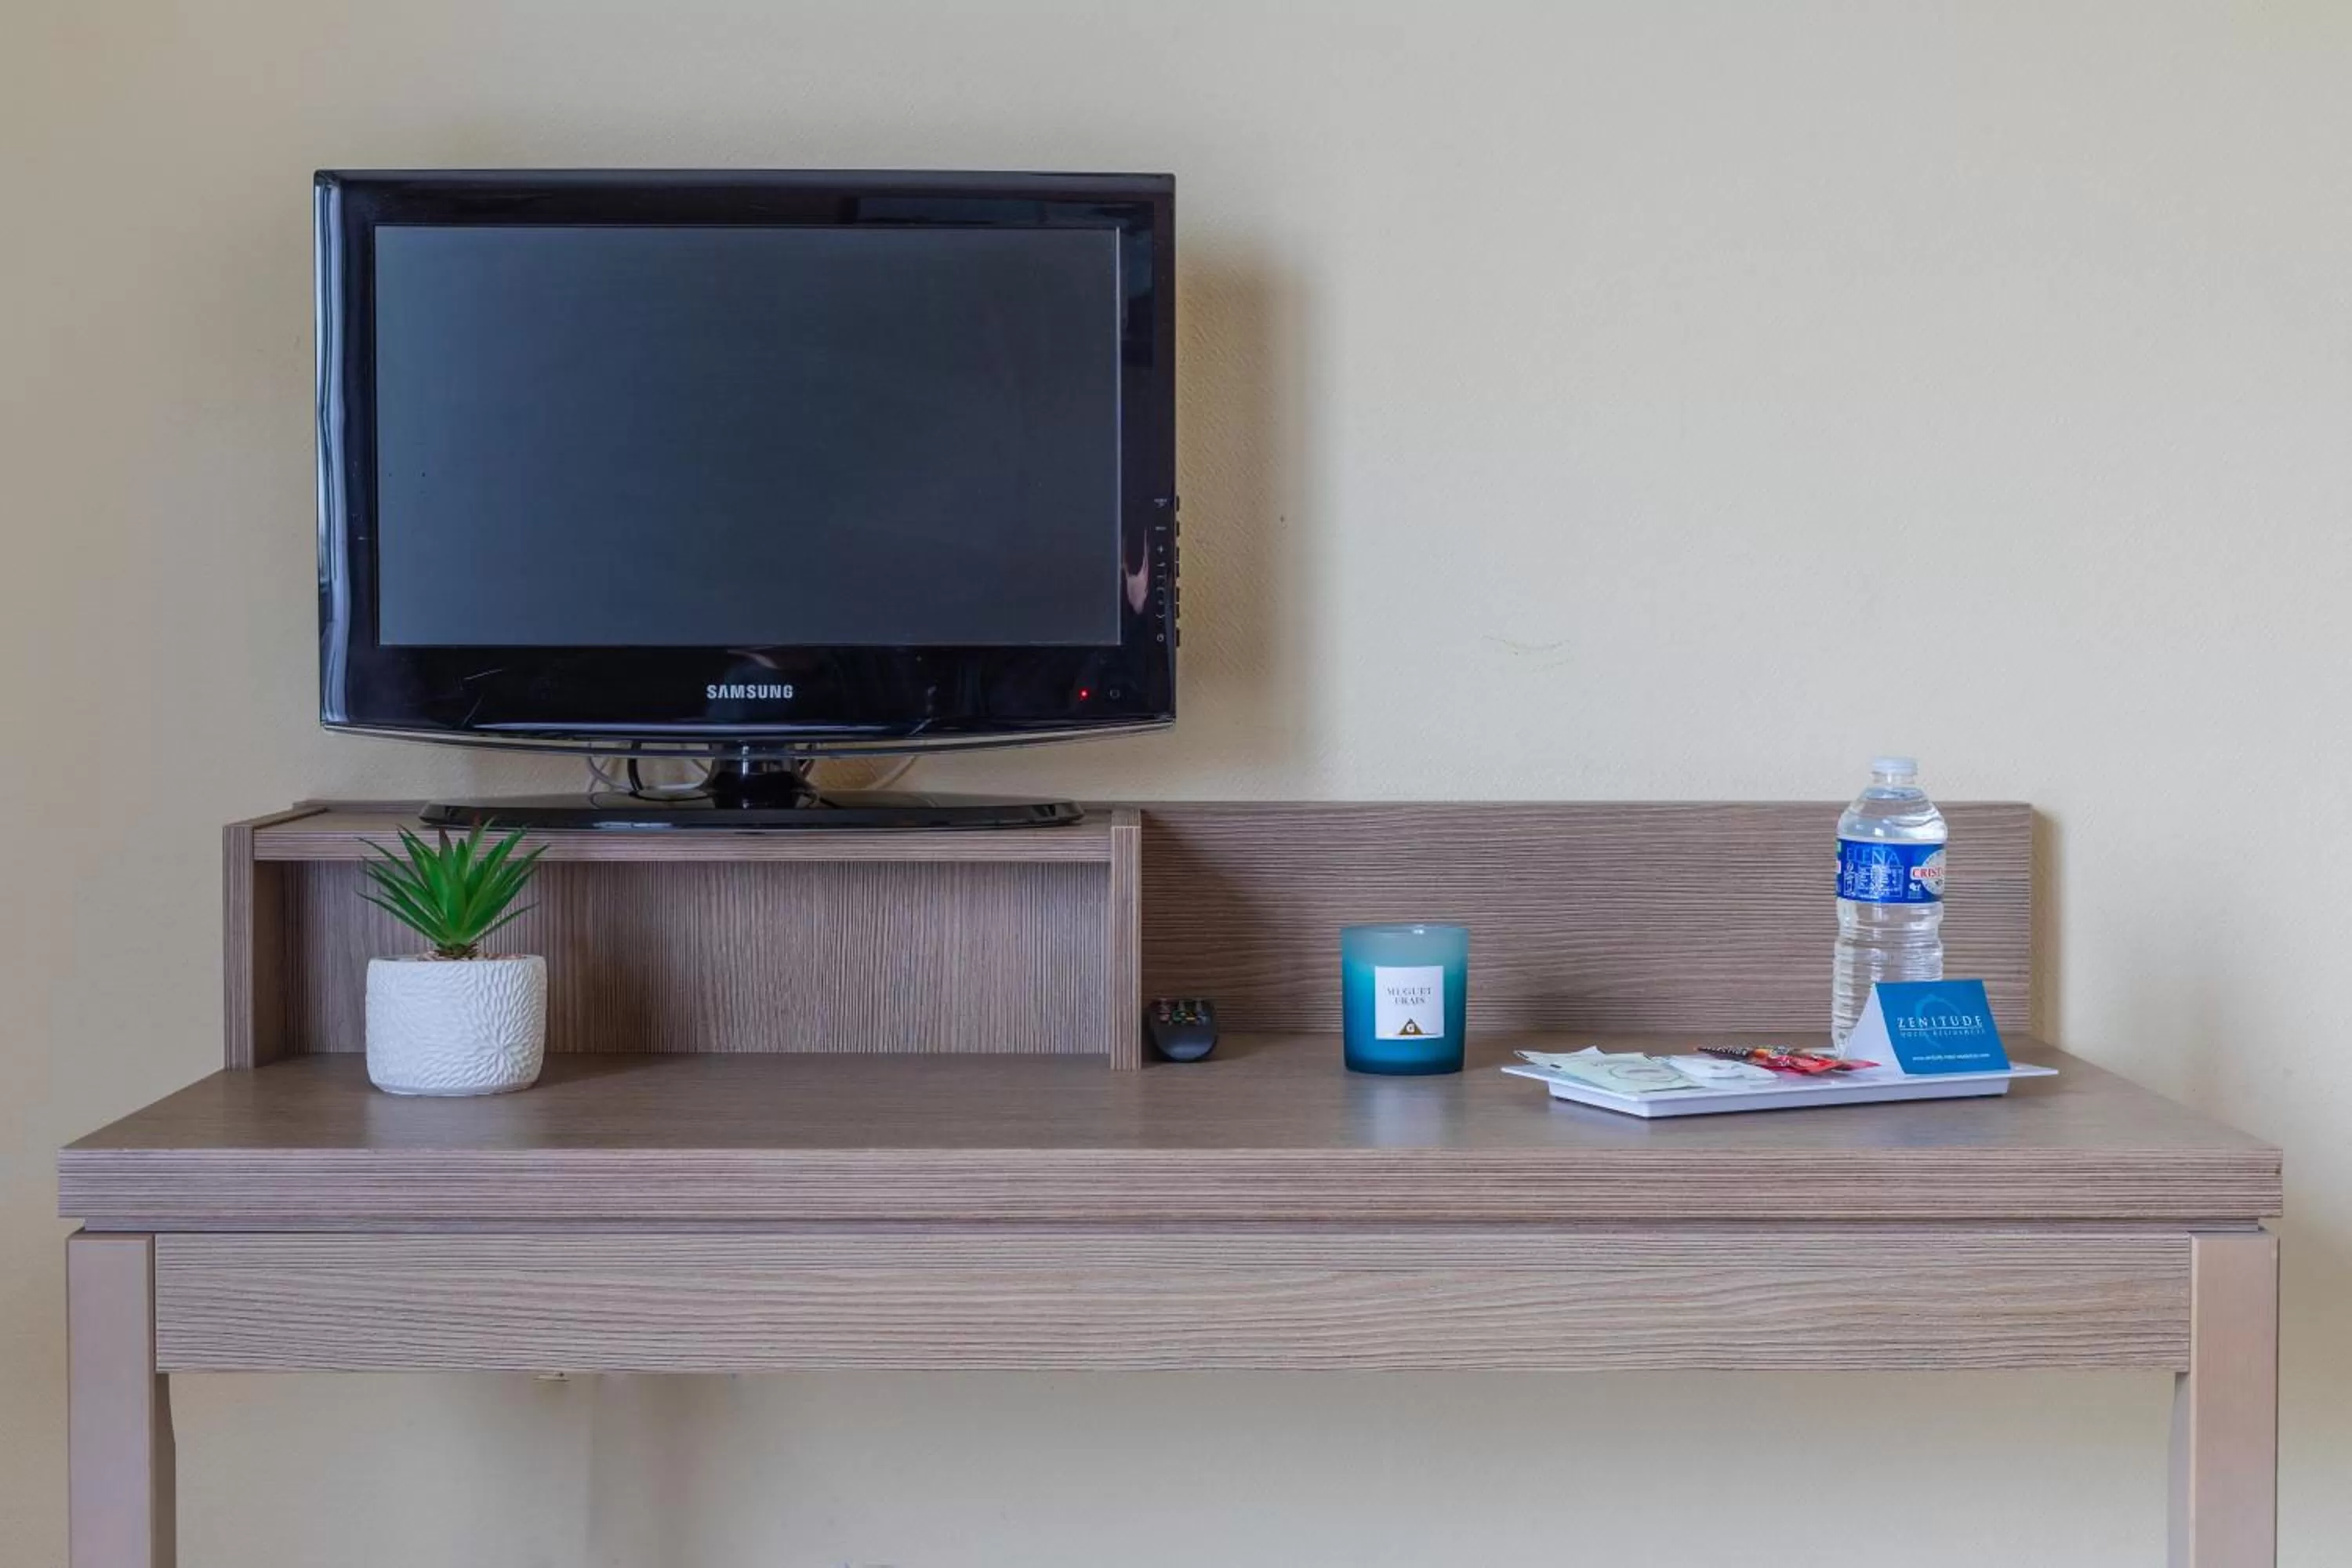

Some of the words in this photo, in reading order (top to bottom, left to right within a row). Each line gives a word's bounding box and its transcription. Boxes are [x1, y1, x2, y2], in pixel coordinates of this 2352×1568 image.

[706, 684, 793, 699] SAMSUNG
[1912, 866, 1944, 878] CRIST
[1897, 1015, 1983, 1028] ZENITUDE
